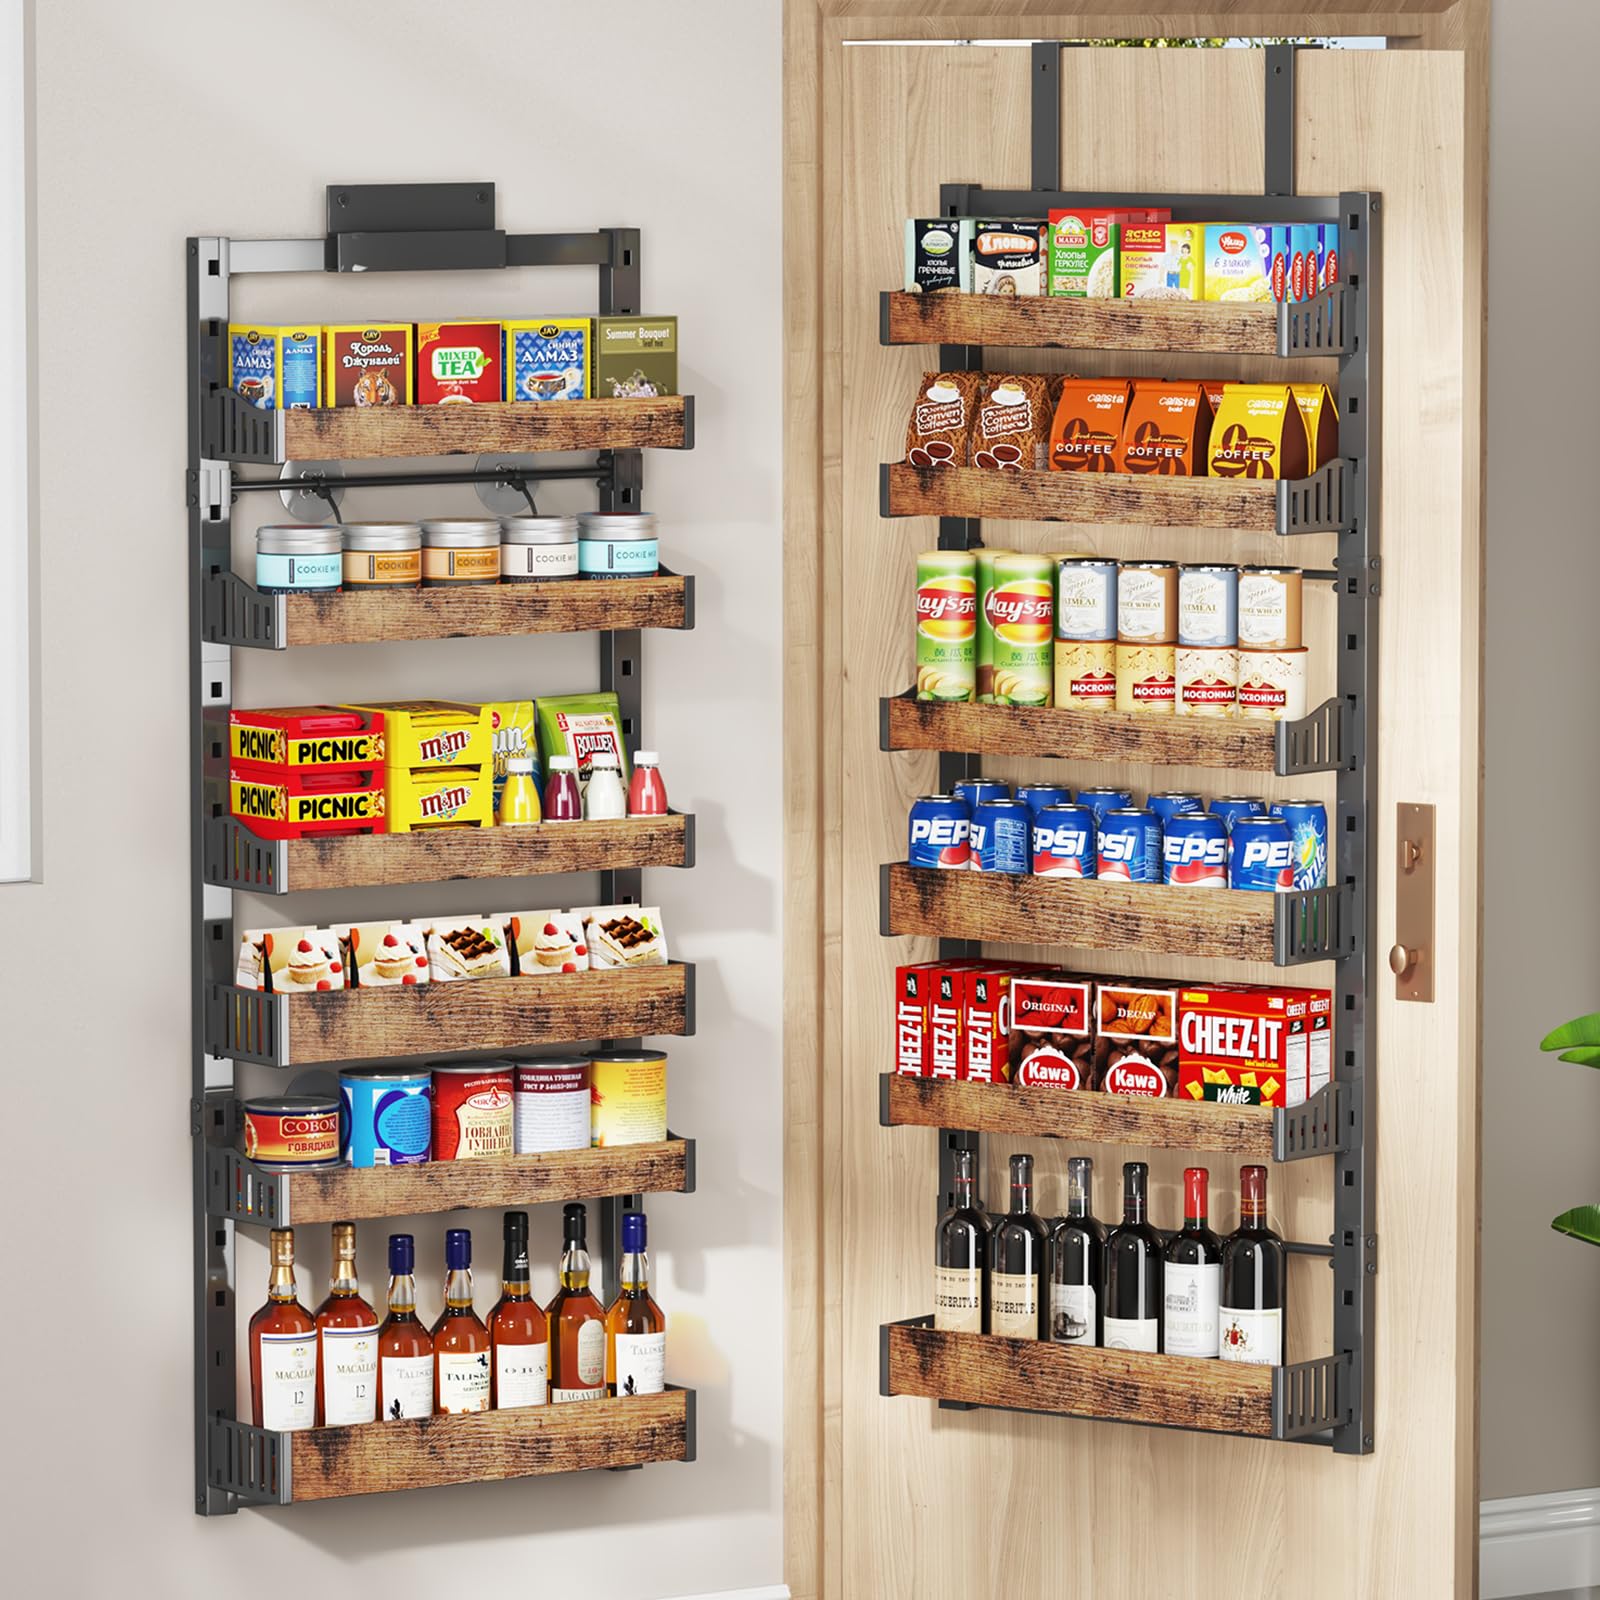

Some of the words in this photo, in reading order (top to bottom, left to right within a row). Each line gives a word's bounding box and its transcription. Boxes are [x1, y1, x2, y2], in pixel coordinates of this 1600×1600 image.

[1125, 283, 1135, 296] 2
[541, 327, 557, 336] JAY
[606, 328, 636, 339] Summer
[639, 327, 670, 340] Bouquet
[438, 351, 477, 360] MIXED
[521, 350, 579, 363] АЛМАЗ
[235, 356, 272, 370] АЛМАЗ
[437, 361, 476, 376] TEA
[1056, 443, 1113, 454] COFFEE
[1127, 446, 1184, 457] COFFEE
[1215, 449, 1271, 461] COFFEE
[456, 557, 489, 566] COOKIE
[535, 554, 567, 563] COOKIE
[616, 551, 646, 560] COOKIE
[297, 565, 329, 574] COOKIE
[377, 561, 409, 570] COOKIE
[917, 594, 958, 618] Lay's
[993, 597, 1035, 622] Lay's
[240, 730, 276, 761] PICNIC
[298, 739, 368, 763] PICNIC
[575, 734, 616, 758] BOULDER
[240, 786, 276, 817] PICNIC
[299, 796, 369, 820] PICNIC
[911, 819, 971, 846] PEP
[1021, 1000, 1078, 1014] ORIGINAL
[1117, 1007, 1156, 1020] DECAF
[1181, 1011, 1282, 1060] CHEEZ-IT
[1028, 1061, 1070, 1082] Kawa
[1115, 1068, 1157, 1089] Kawa
[1216, 1084, 1251, 1105] White
[283, 1118, 337, 1133] СОВОК
[287, 1139, 336, 1152] ГОВЯДИНА
[294, 1390, 304, 1405] 12
[355, 1384, 366, 1399] 12
